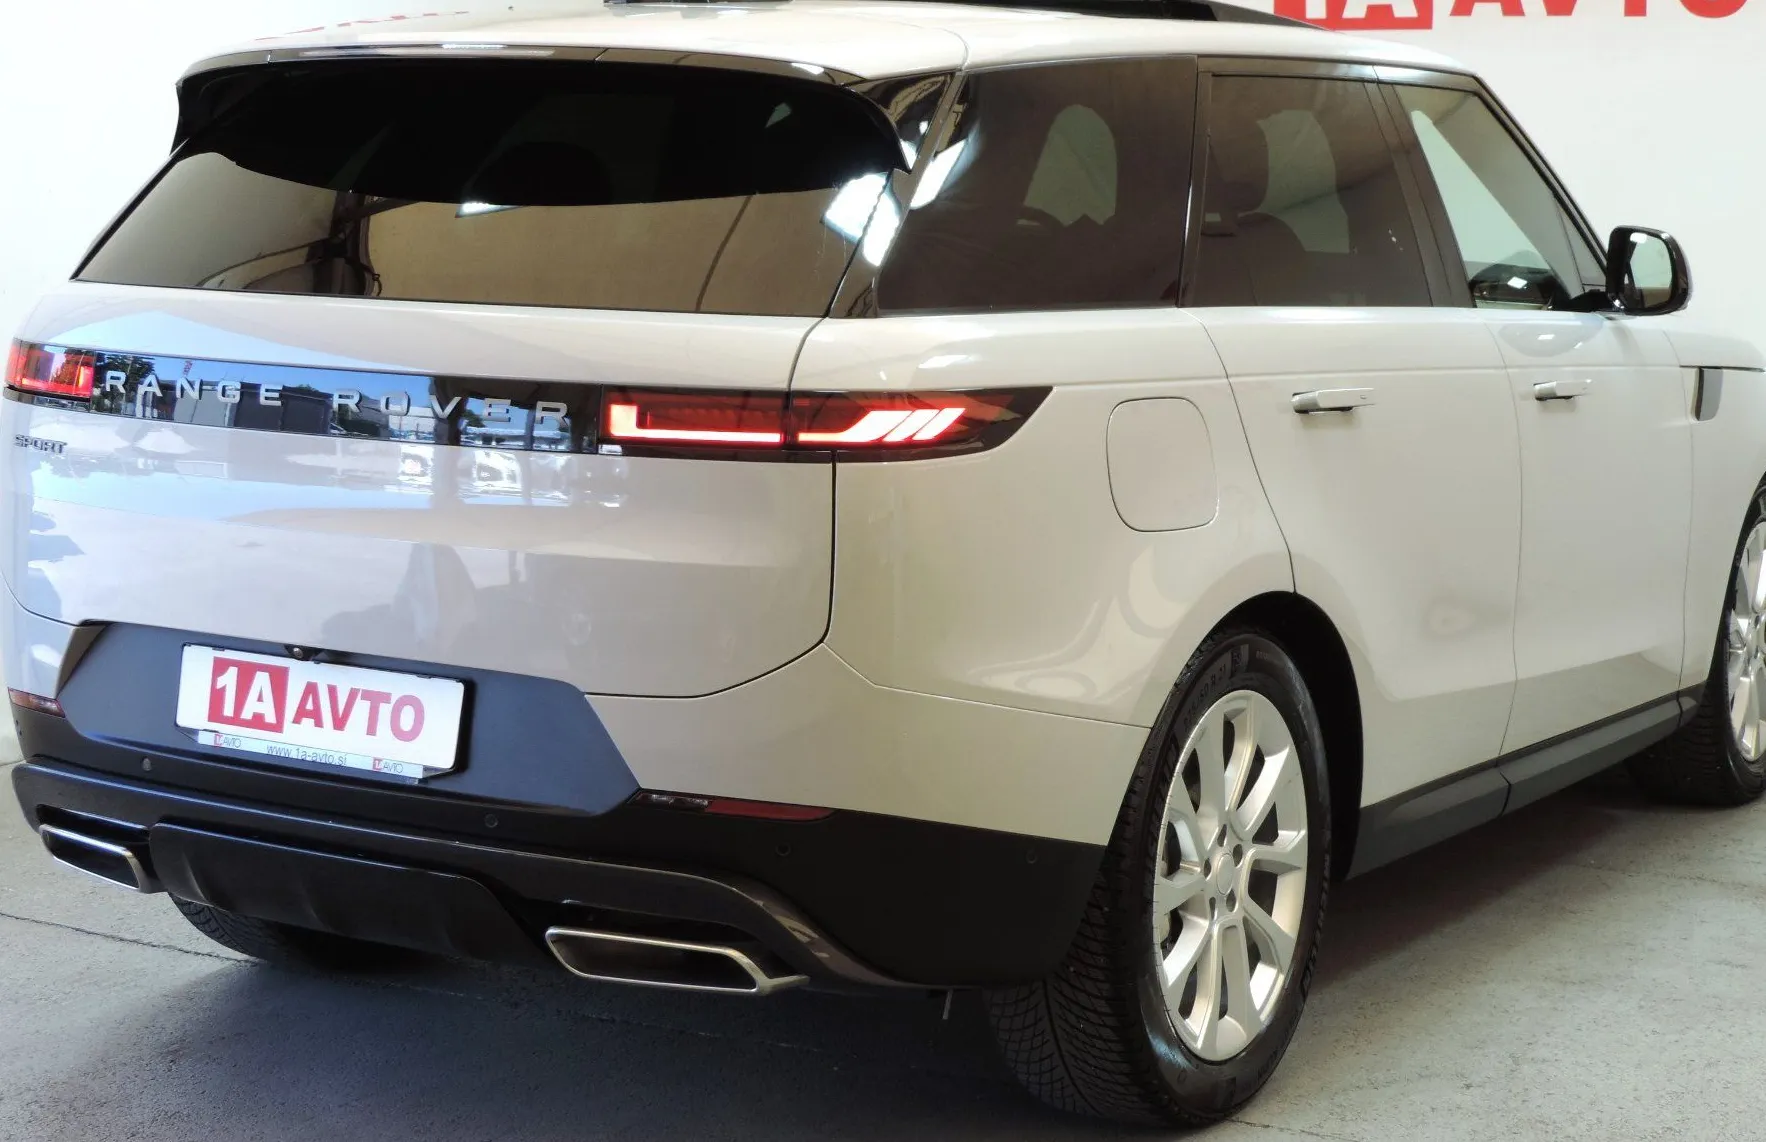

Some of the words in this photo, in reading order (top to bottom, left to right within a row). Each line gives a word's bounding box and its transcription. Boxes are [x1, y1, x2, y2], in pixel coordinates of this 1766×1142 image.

[106, 370, 284, 407] RANGE
[333, 389, 570, 427] ROVER
[14, 433, 67, 454] SPORT
[216, 666, 277, 724] 1A
[292, 681, 425, 743] AVTO
[266, 744, 348, 766] www.1a-avto.si
